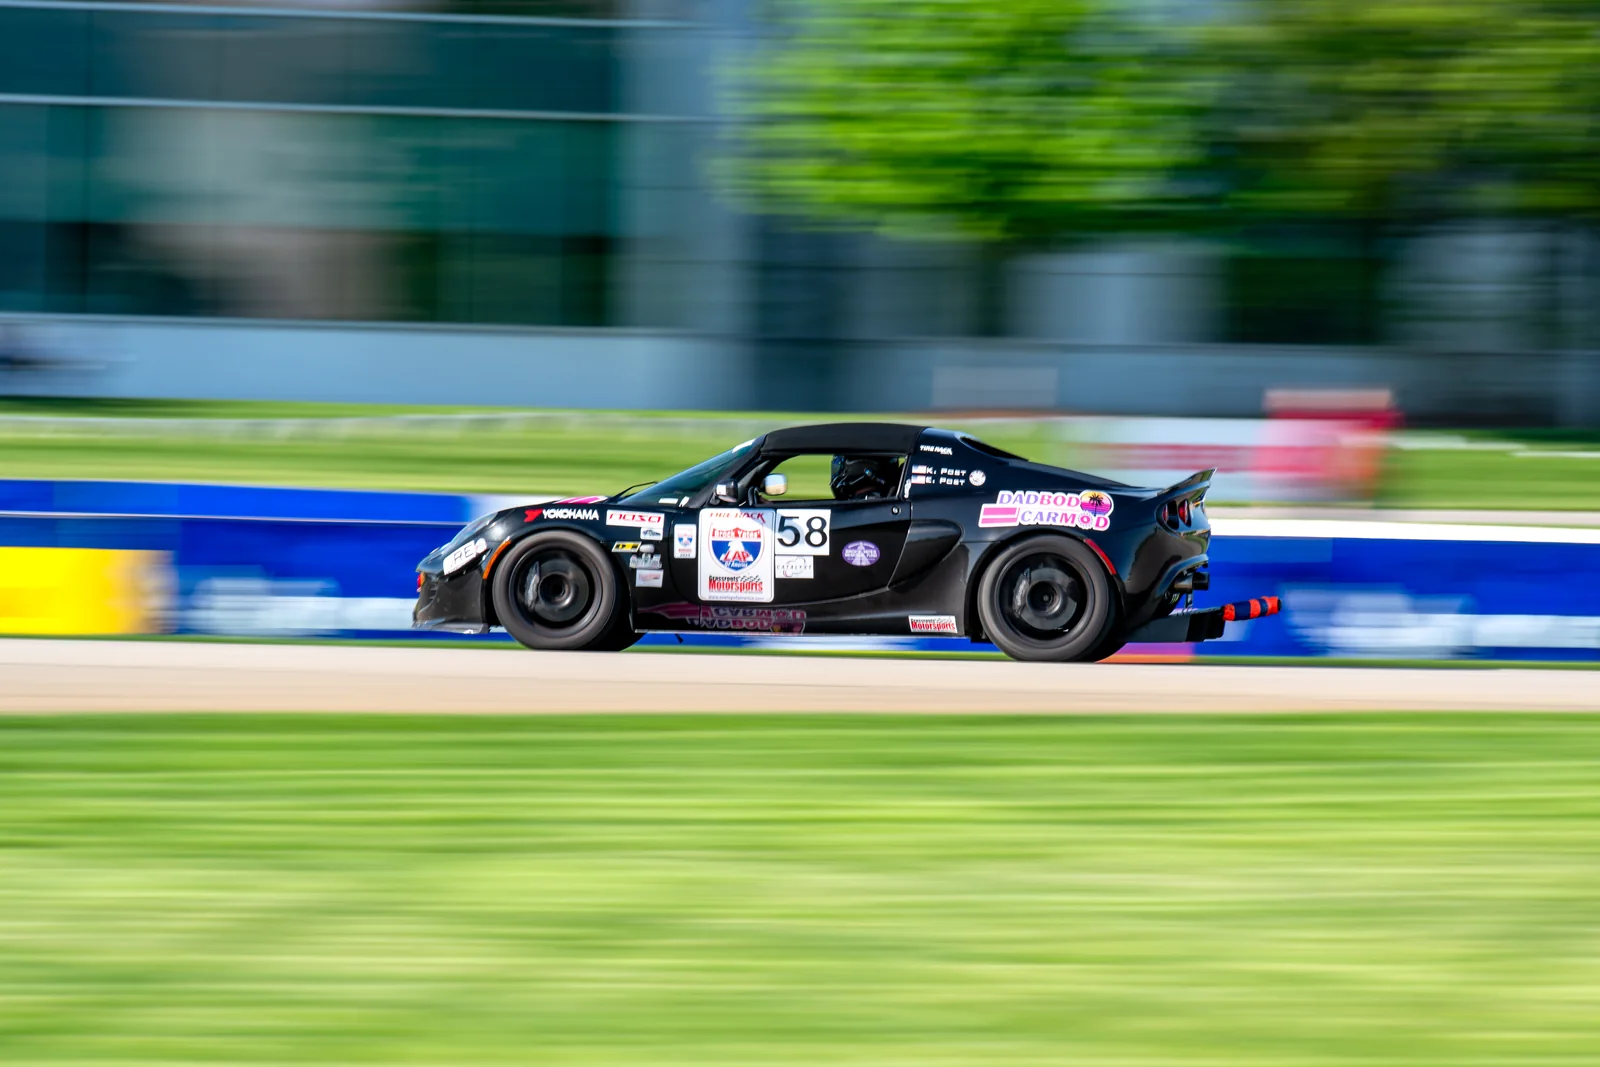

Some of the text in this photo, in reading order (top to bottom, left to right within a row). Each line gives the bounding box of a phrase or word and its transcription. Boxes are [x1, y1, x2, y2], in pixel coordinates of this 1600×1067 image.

[999, 493, 1080, 508] DADBOD
[542, 508, 600, 520] YOKOHAMA
[777, 516, 828, 548] 58
[723, 550, 751, 562] LAP
[708, 580, 763, 593] Motorsports
[911, 621, 956, 631] Motorsports
